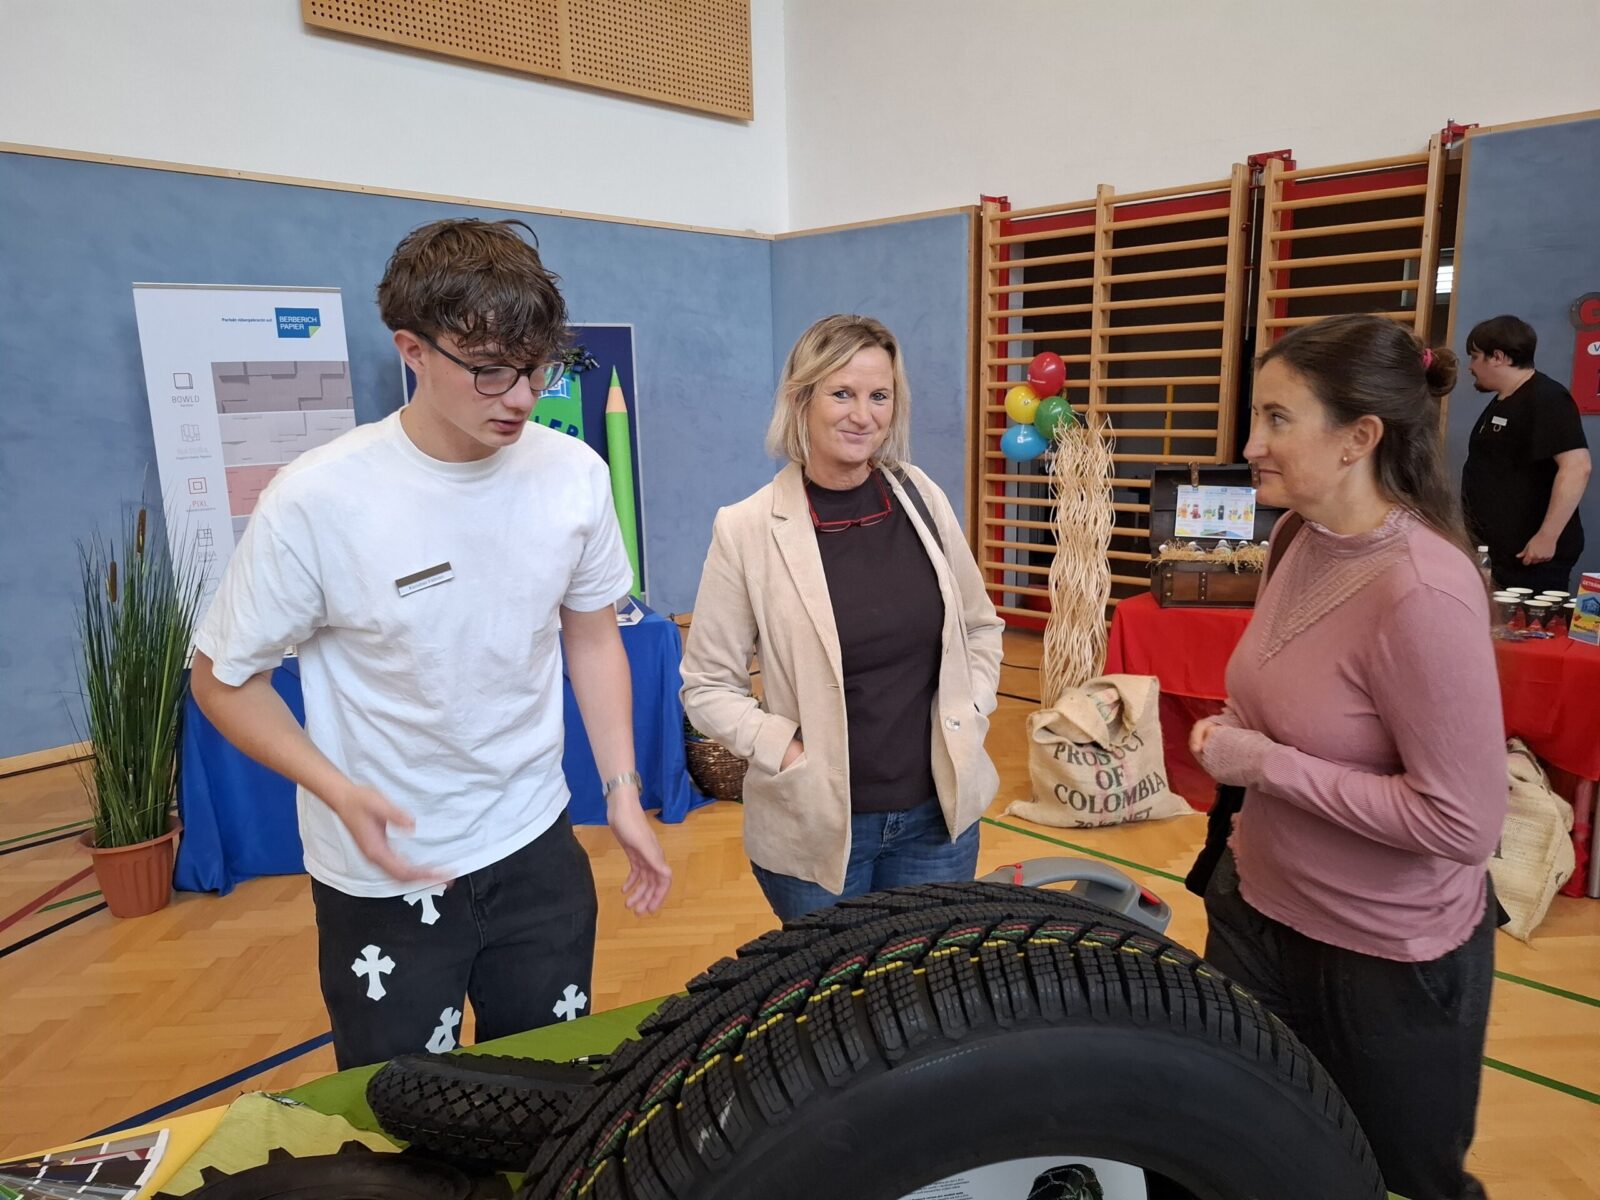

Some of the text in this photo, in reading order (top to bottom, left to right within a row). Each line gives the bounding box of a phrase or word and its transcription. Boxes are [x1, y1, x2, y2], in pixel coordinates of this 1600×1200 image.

[279, 315, 318, 323] BERBERICH
[280, 323, 305, 331] PAPIER
[1095, 765, 1124, 790] OF
[1054, 771, 1166, 814] COLOMBIA
